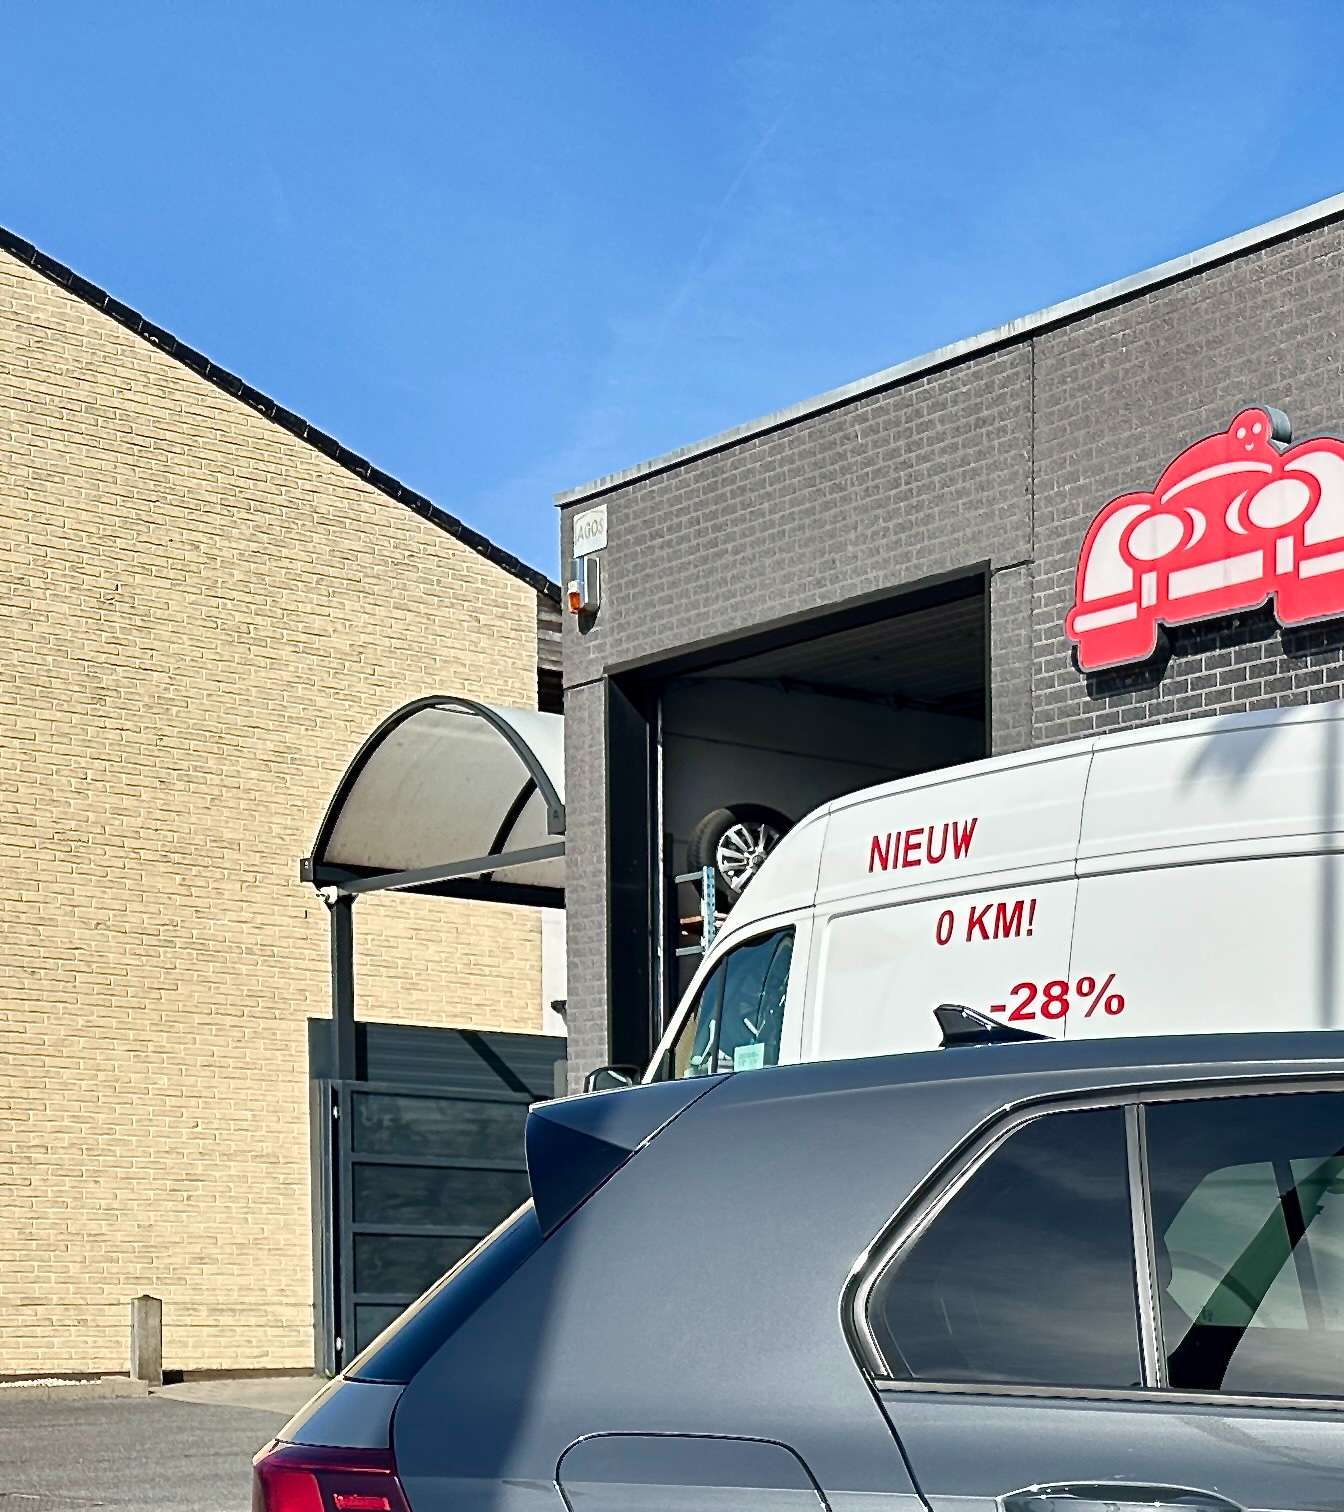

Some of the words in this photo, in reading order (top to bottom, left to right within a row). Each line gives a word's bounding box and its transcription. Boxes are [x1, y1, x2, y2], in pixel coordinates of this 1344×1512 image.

[869, 818, 977, 873] NIEUW
[936, 910, 954, 946] 0
[967, 899, 1036, 943] KM!
[989, 974, 1126, 1022] -28%
